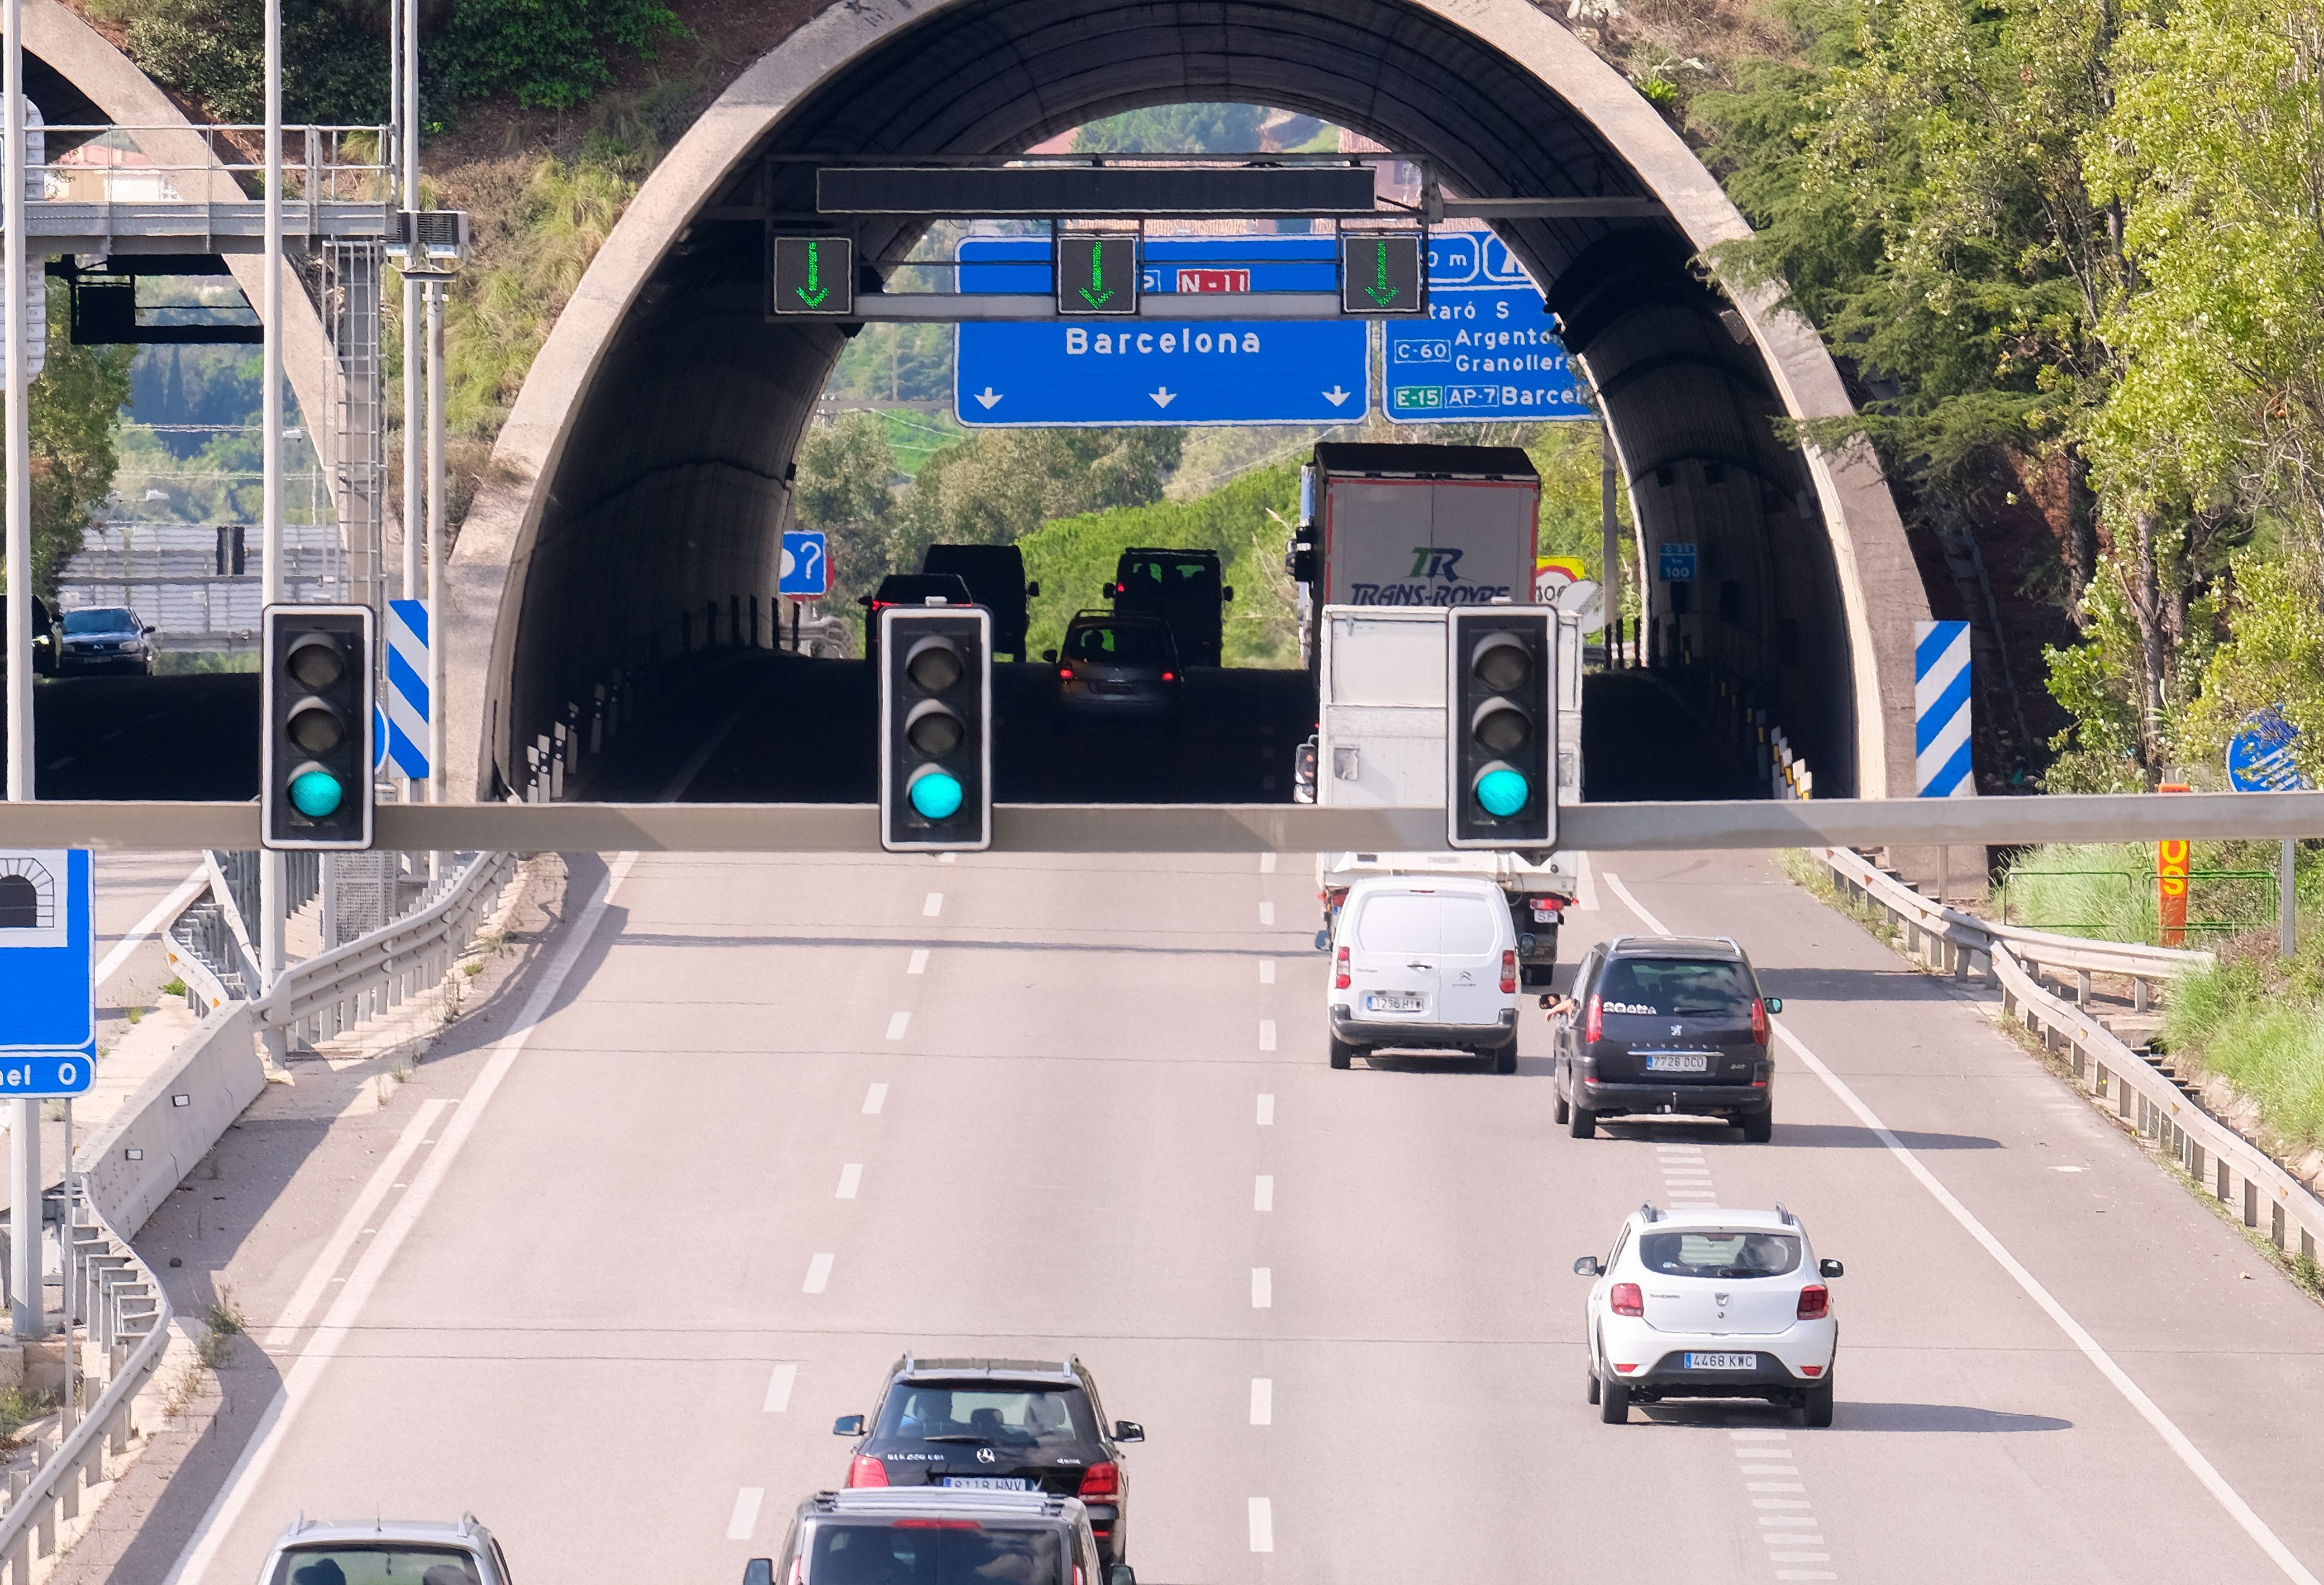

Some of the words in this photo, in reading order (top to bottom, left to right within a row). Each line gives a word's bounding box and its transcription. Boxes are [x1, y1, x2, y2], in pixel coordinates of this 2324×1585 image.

[1449, 254, 1467, 266] m
[1429, 301, 1476, 320] taró
[1496, 301, 1509, 319] S
[1065, 327, 1260, 355] Barcelona
[1455, 328, 1551, 350] Argento
[1398, 342, 1447, 359] C-60
[1397, 390, 1439, 407] E-15
[1449, 390, 1495, 405] AP-7
[1409, 547, 1464, 583] TR
[1666, 566, 1690, 579] 100
[2161, 841, 2187, 895] OS
[1537, 911, 1555, 922] SP
[1694, 1355, 1725, 1367] 4468
